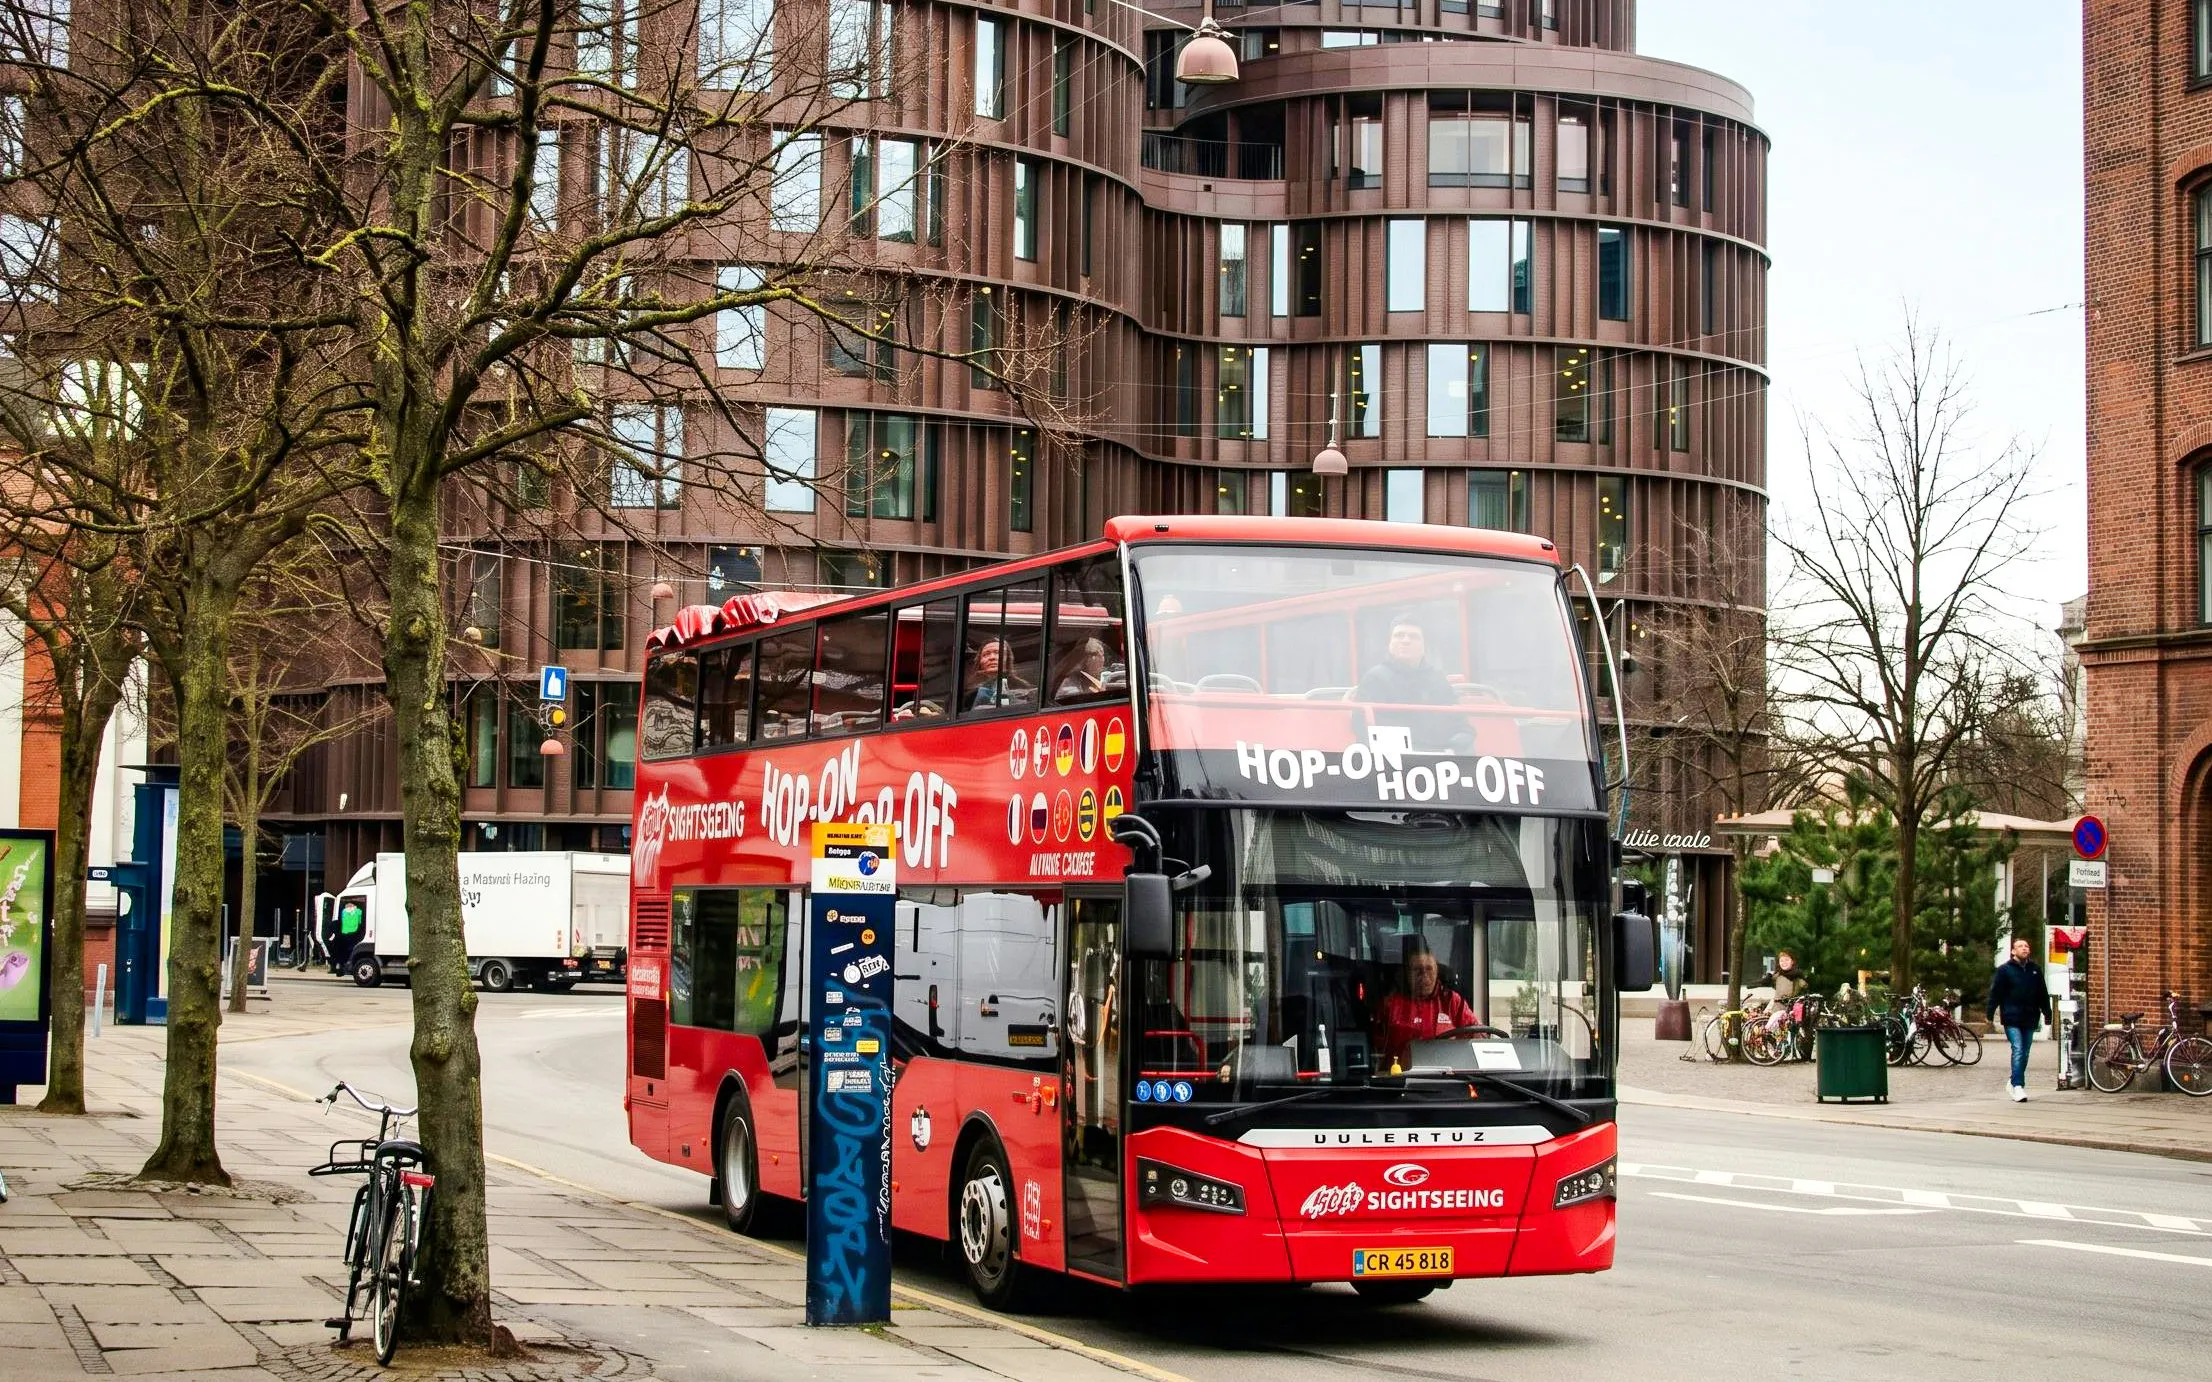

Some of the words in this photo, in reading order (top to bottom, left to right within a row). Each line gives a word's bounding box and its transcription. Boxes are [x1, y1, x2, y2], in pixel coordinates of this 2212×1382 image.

[1236, 740, 1404, 790] HOP-ON
[1376, 755, 1545, 806] HOP-OFF
[761, 738, 861, 848] HOP-ON
[1367, 1189, 1504, 1210] SIGHTSEEING
[1366, 1254, 1390, 1271] CR
[1395, 1253, 1415, 1270] 45
[1419, 1252, 1449, 1269] 818
